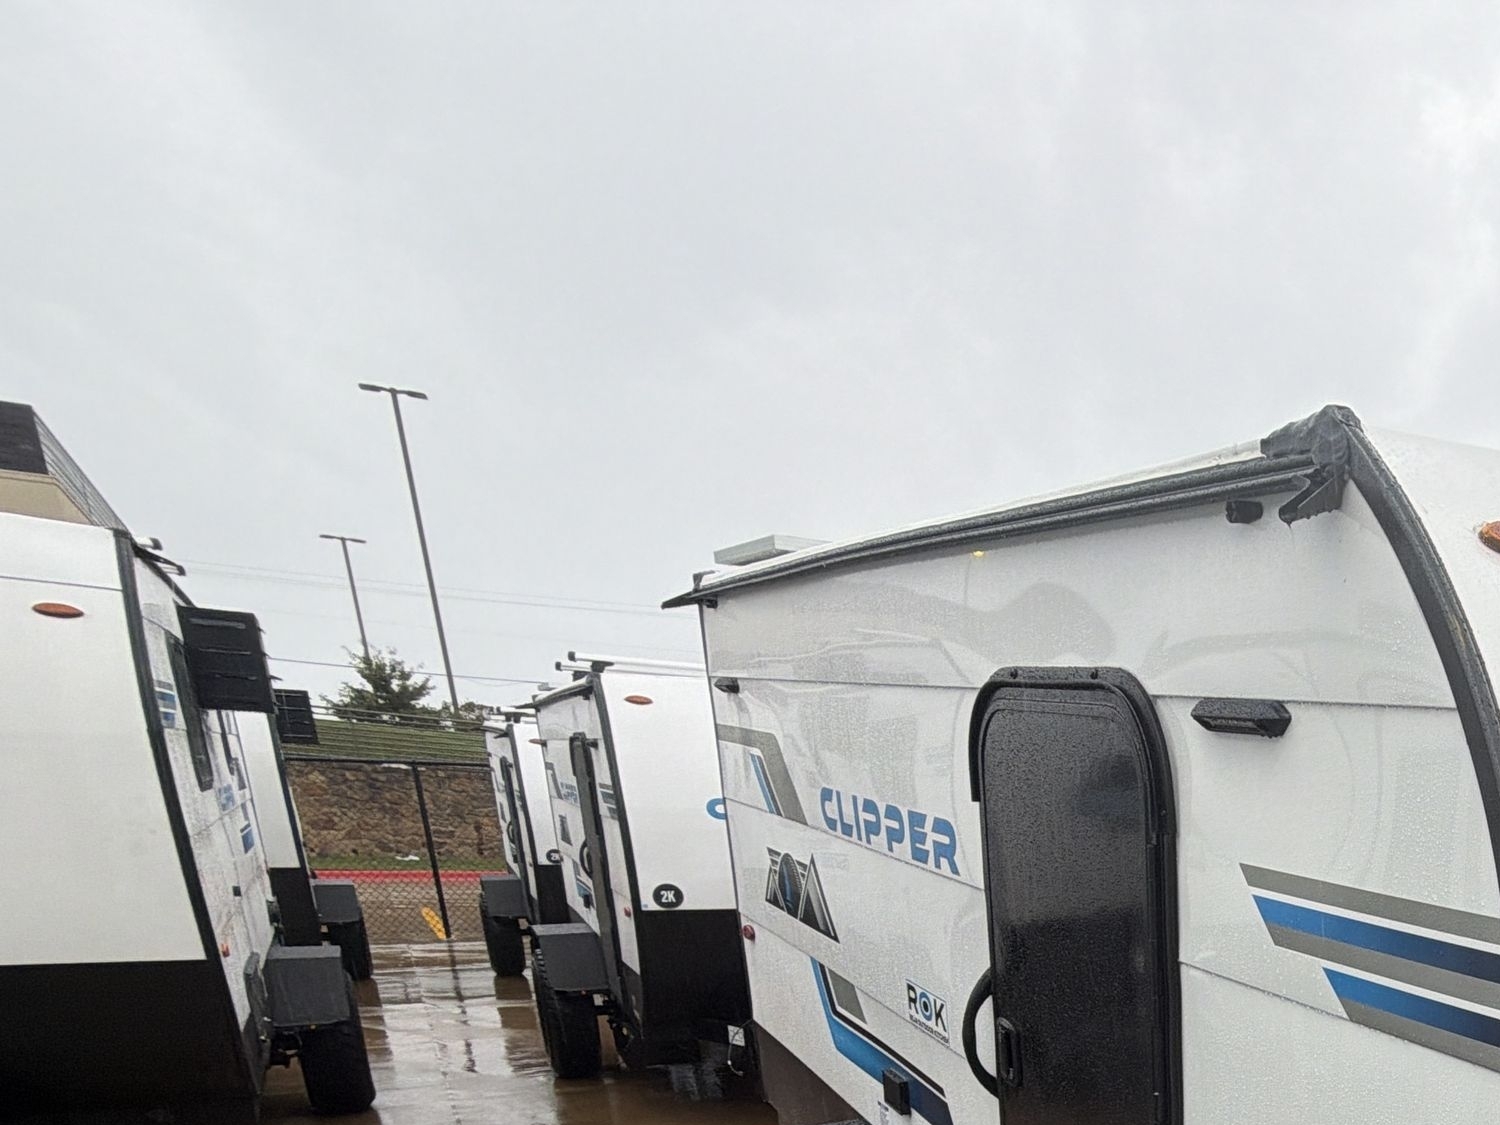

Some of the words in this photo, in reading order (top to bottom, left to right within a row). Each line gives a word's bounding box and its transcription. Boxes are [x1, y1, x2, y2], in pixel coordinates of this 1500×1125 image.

[820, 786, 961, 877] CLIPPER
[660, 890, 676, 903] 2K
[907, 982, 947, 1033] ROK
